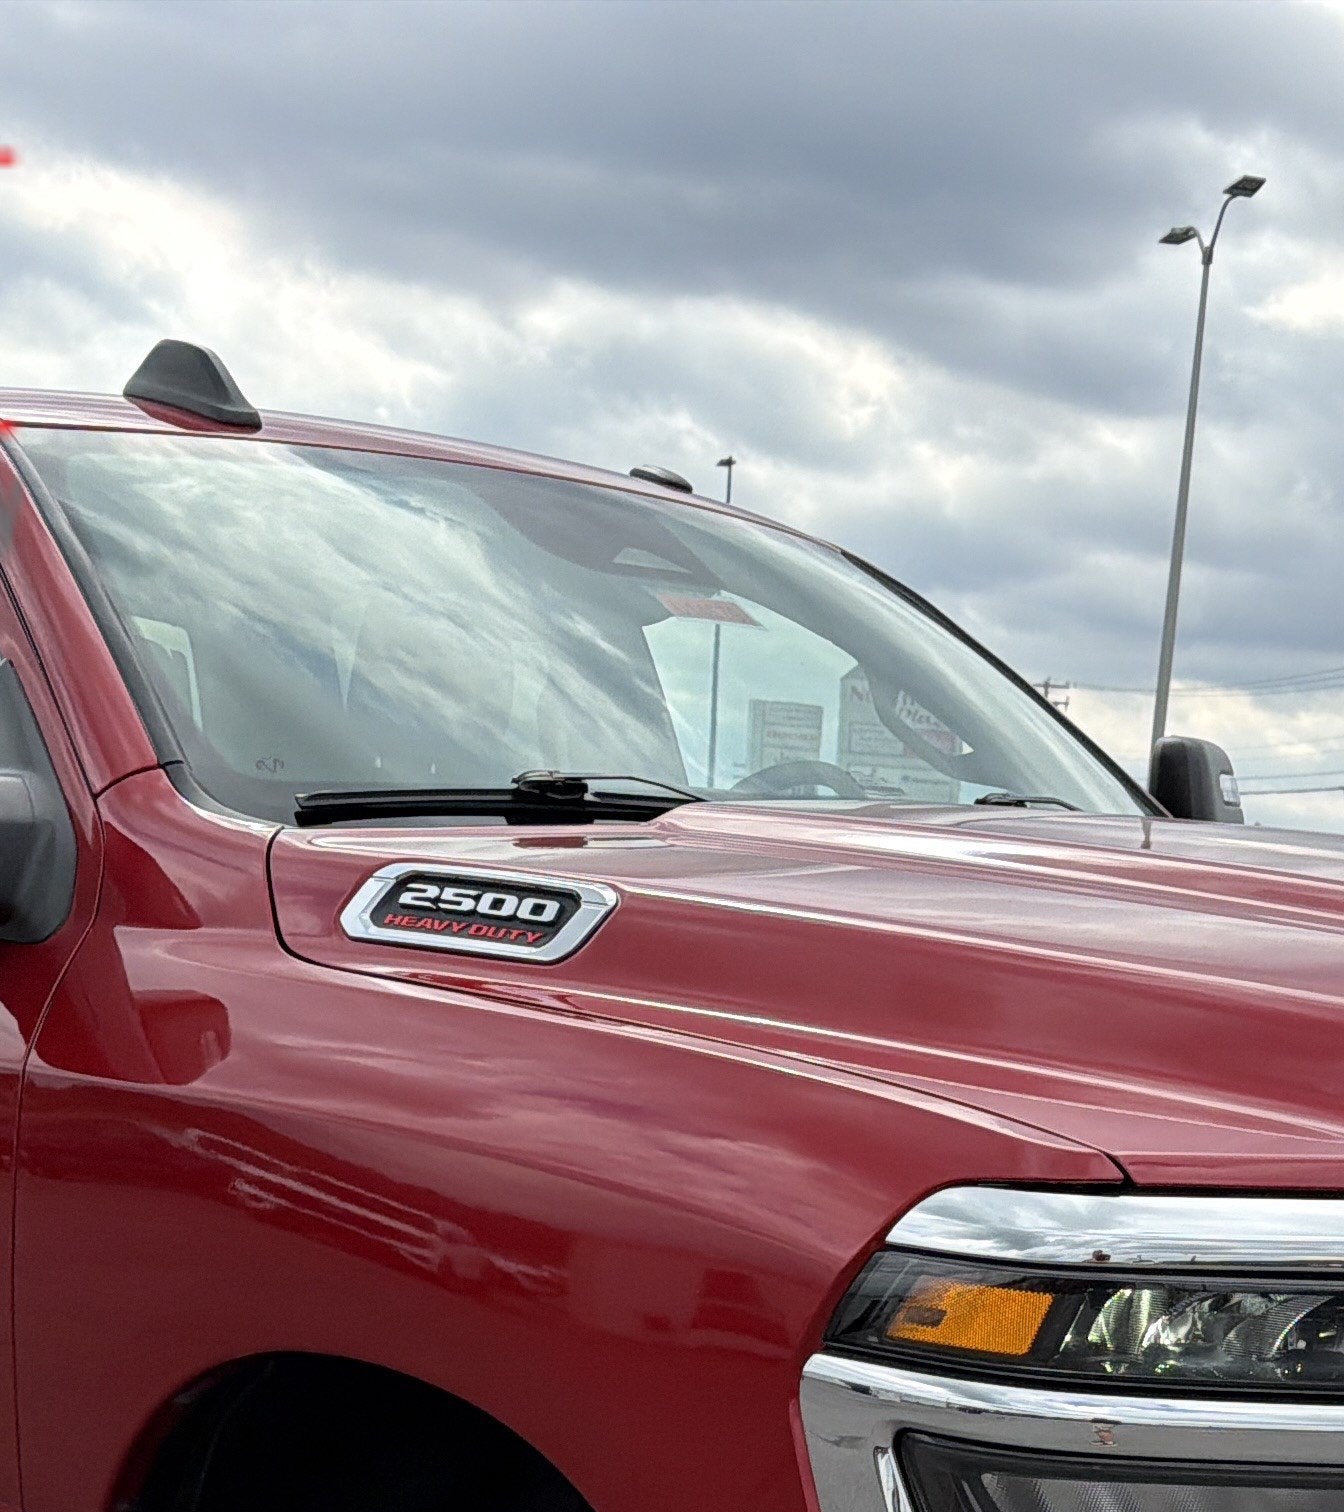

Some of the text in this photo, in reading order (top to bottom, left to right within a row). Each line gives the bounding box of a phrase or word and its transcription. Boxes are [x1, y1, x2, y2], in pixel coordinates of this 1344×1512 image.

[398, 883, 561, 924] 2500
[383, 913, 544, 944] HEAVY DUTY
